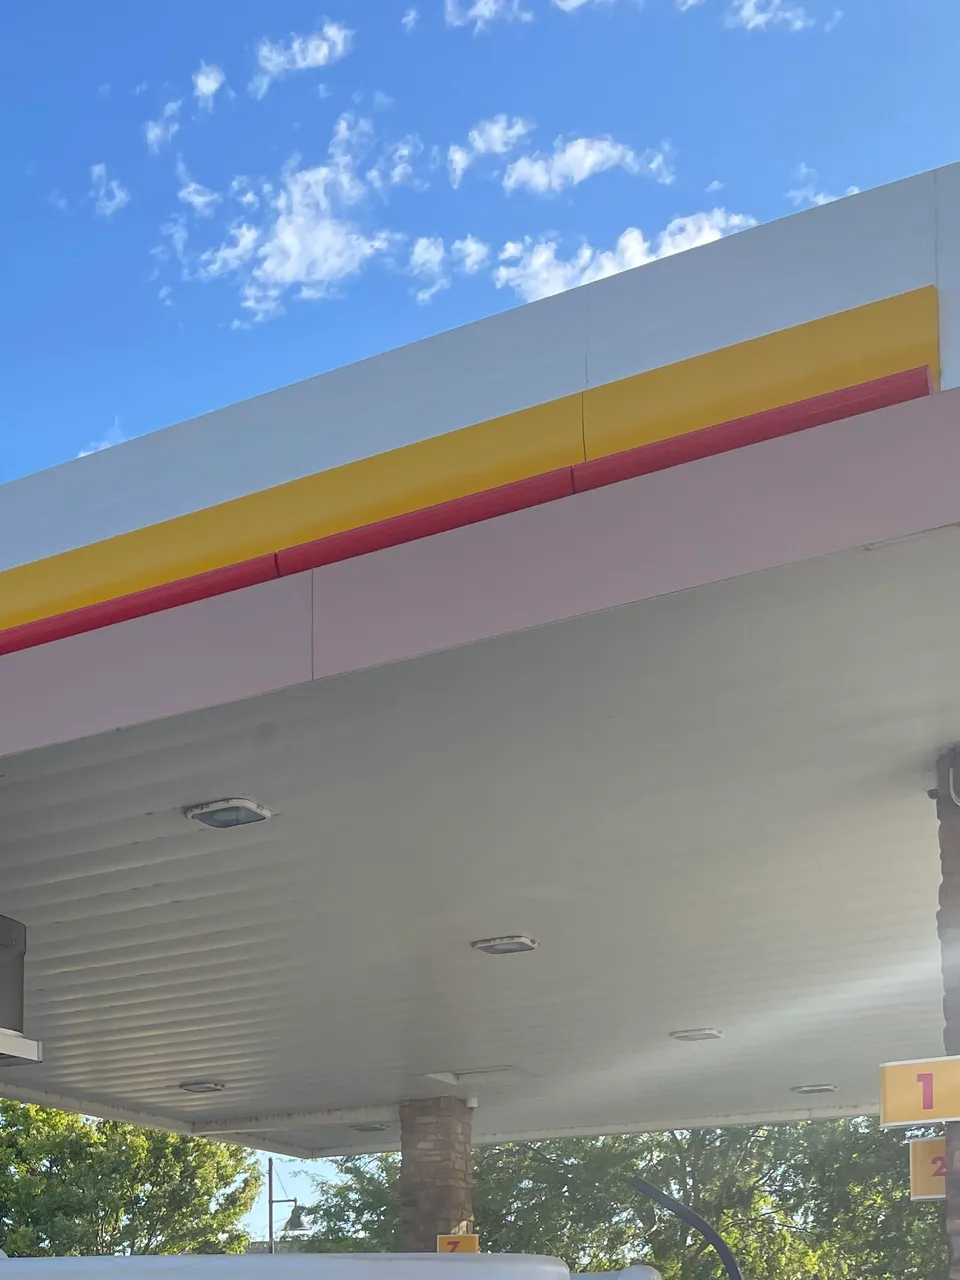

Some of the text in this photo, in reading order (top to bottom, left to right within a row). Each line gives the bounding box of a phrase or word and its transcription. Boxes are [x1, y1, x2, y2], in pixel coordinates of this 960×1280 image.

[916, 1072, 934, 1110] 1
[930, 1156, 947, 1177] 2
[446, 1240, 460, 1253] 7
